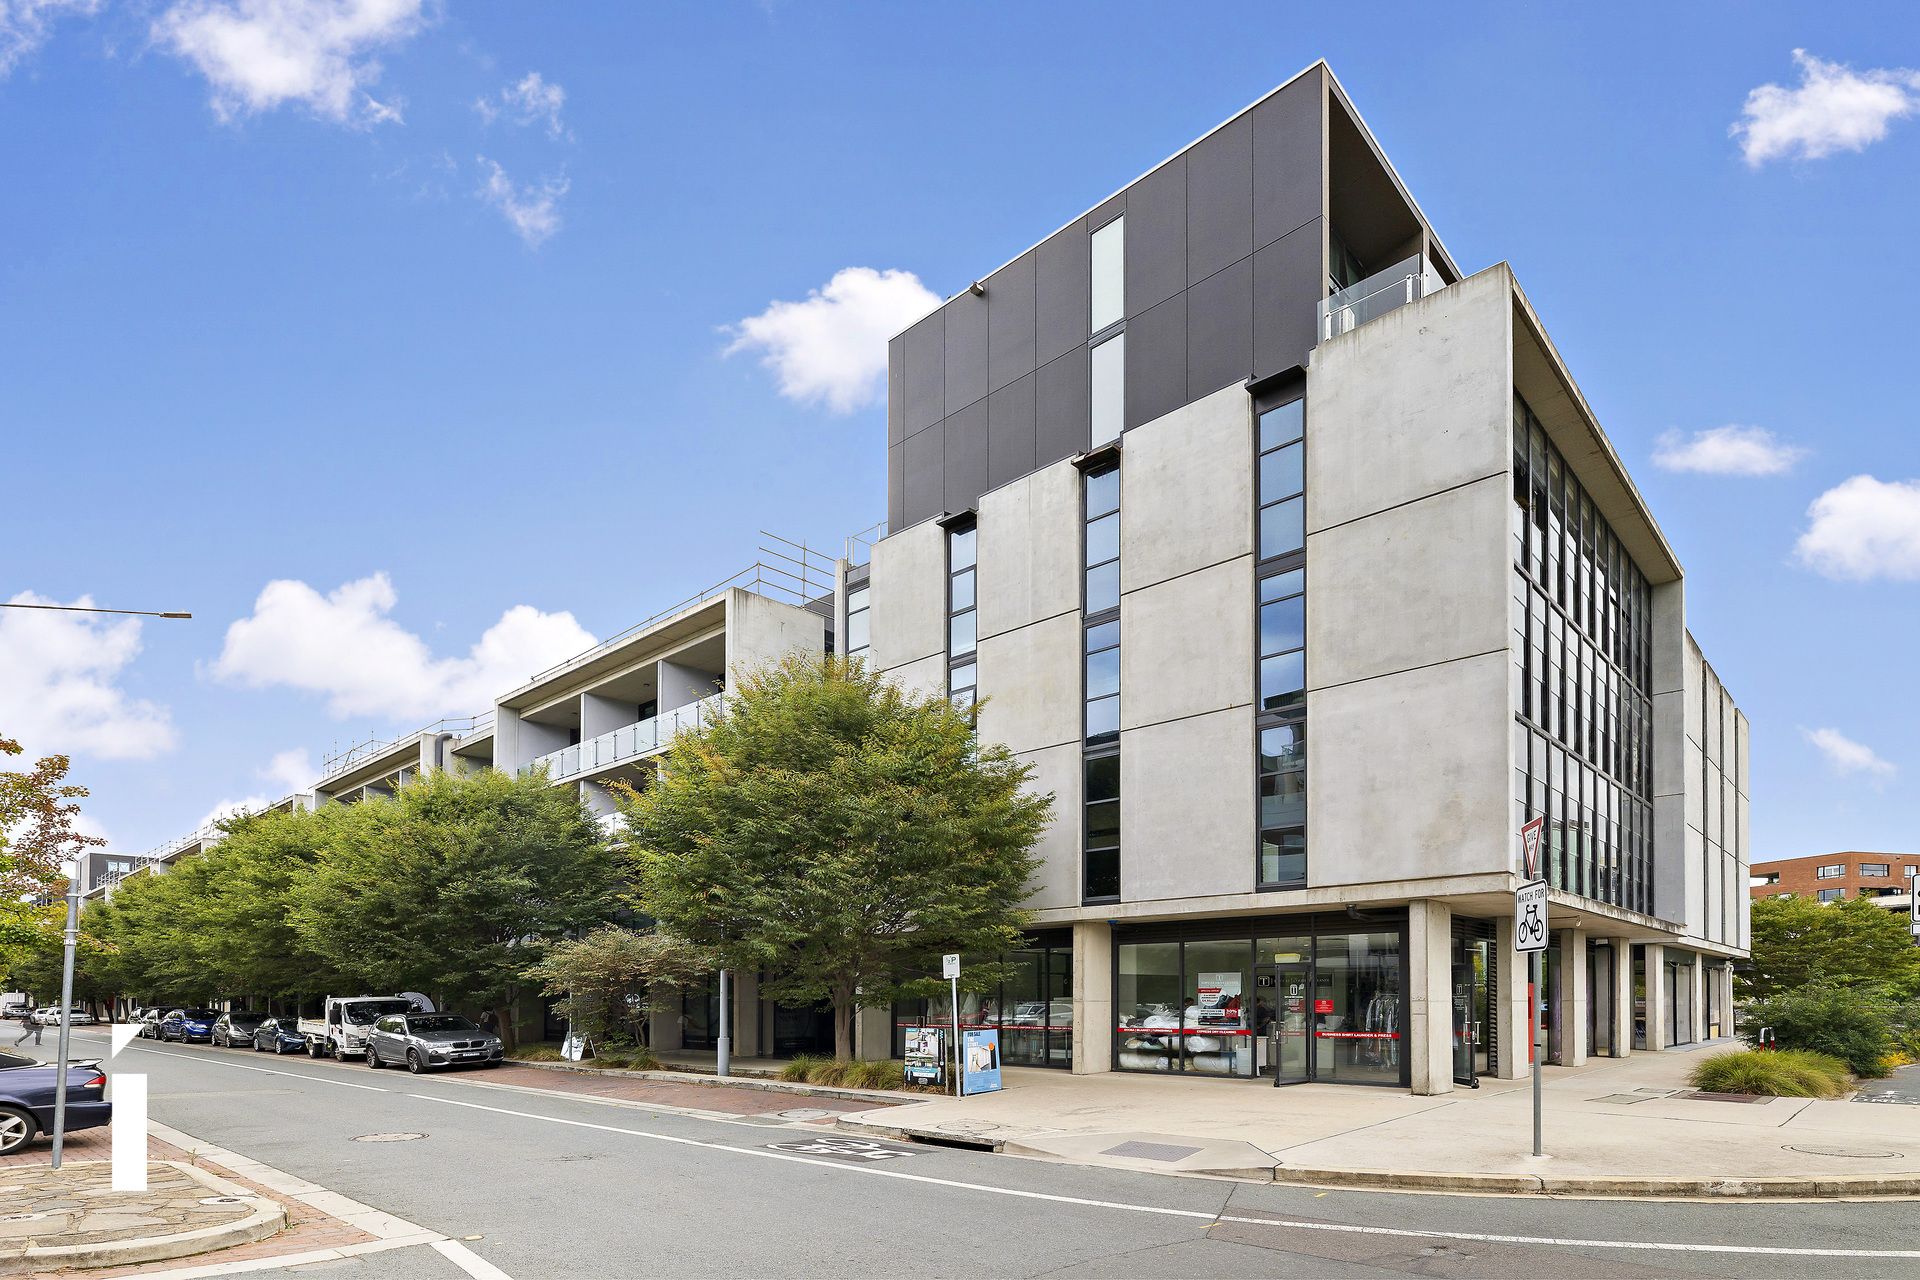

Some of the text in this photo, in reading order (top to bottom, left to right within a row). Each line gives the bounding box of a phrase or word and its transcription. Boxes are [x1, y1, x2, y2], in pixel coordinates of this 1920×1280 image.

[1527, 830, 1537, 843] GIVE
[1518, 888, 1545, 903] WATCH FOR
